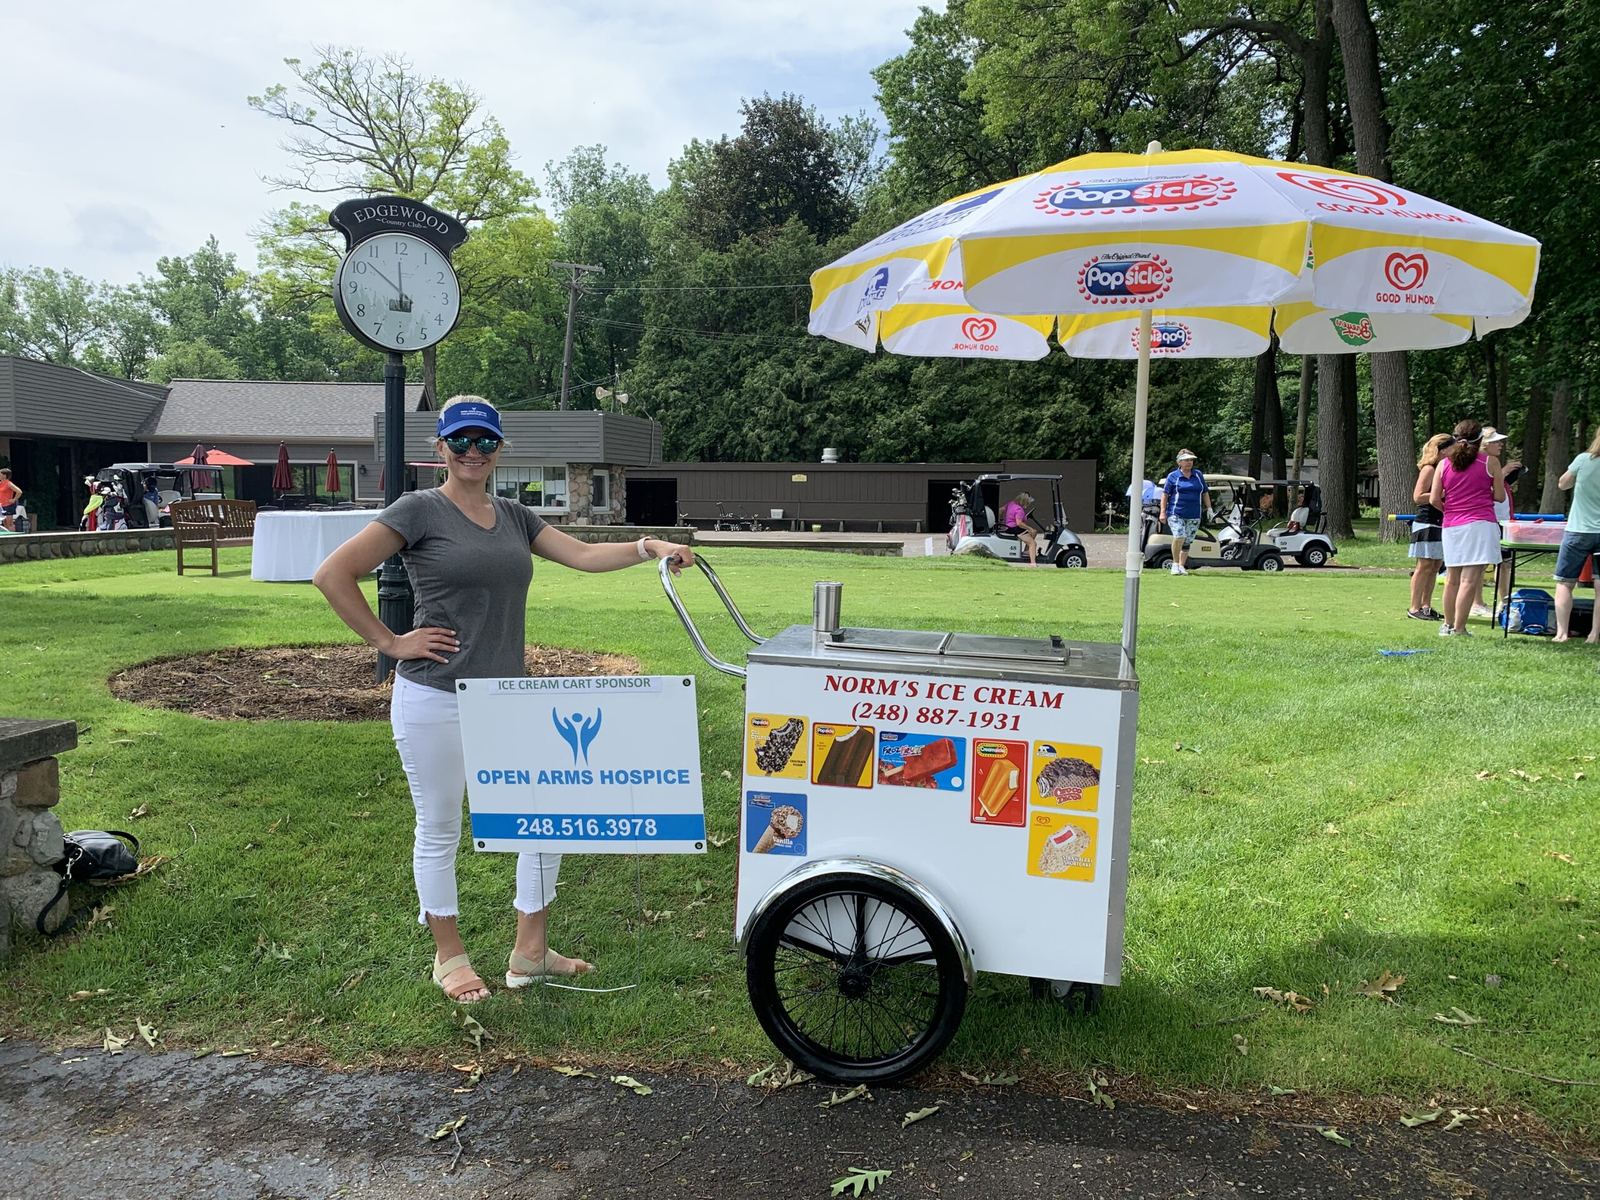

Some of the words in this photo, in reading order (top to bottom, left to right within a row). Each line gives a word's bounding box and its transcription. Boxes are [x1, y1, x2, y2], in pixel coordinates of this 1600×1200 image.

[1053, 180, 1218, 204] Popsicle
[353, 204, 449, 235] EDGEWOOD
[1317, 202, 1385, 215] GOOD
[1387, 208, 1467, 224] HUMOR
[381, 217, 407, 228] Country
[369, 246, 379, 258] 11
[395, 242, 408, 256] 12
[352, 261, 367, 274] 10
[437, 271, 446, 285] 2
[1087, 265, 1165, 290] Popsicle
[350, 281, 358, 294] 9
[441, 292, 449, 305] 3
[1376, 292, 1401, 304] GOOD
[1405, 293, 1435, 305] HUMOR
[356, 304, 365, 317] 8
[434, 313, 443, 326] 4
[374, 322, 382, 335] 7
[421, 328, 427, 340] 5
[396, 331, 405, 344] 6
[498, 680, 515, 690] ICE
[518, 679, 559, 690] CREAM
[562, 678, 592, 689] CART
[595, 677, 651, 689] SPONSOR
[824, 674, 919, 698] NORM'S
[925, 682, 967, 701] ICE
[973, 686, 1064, 709] CREAM
[851, 701, 908, 725] (248)
[916, 707, 1021, 731] 887-1931
[477, 769, 531, 785] OPEN
[537, 769, 593, 785] ARMS
[600, 769, 690, 785] HOSPICE
[516, 818, 658, 837] 248.516.3978
